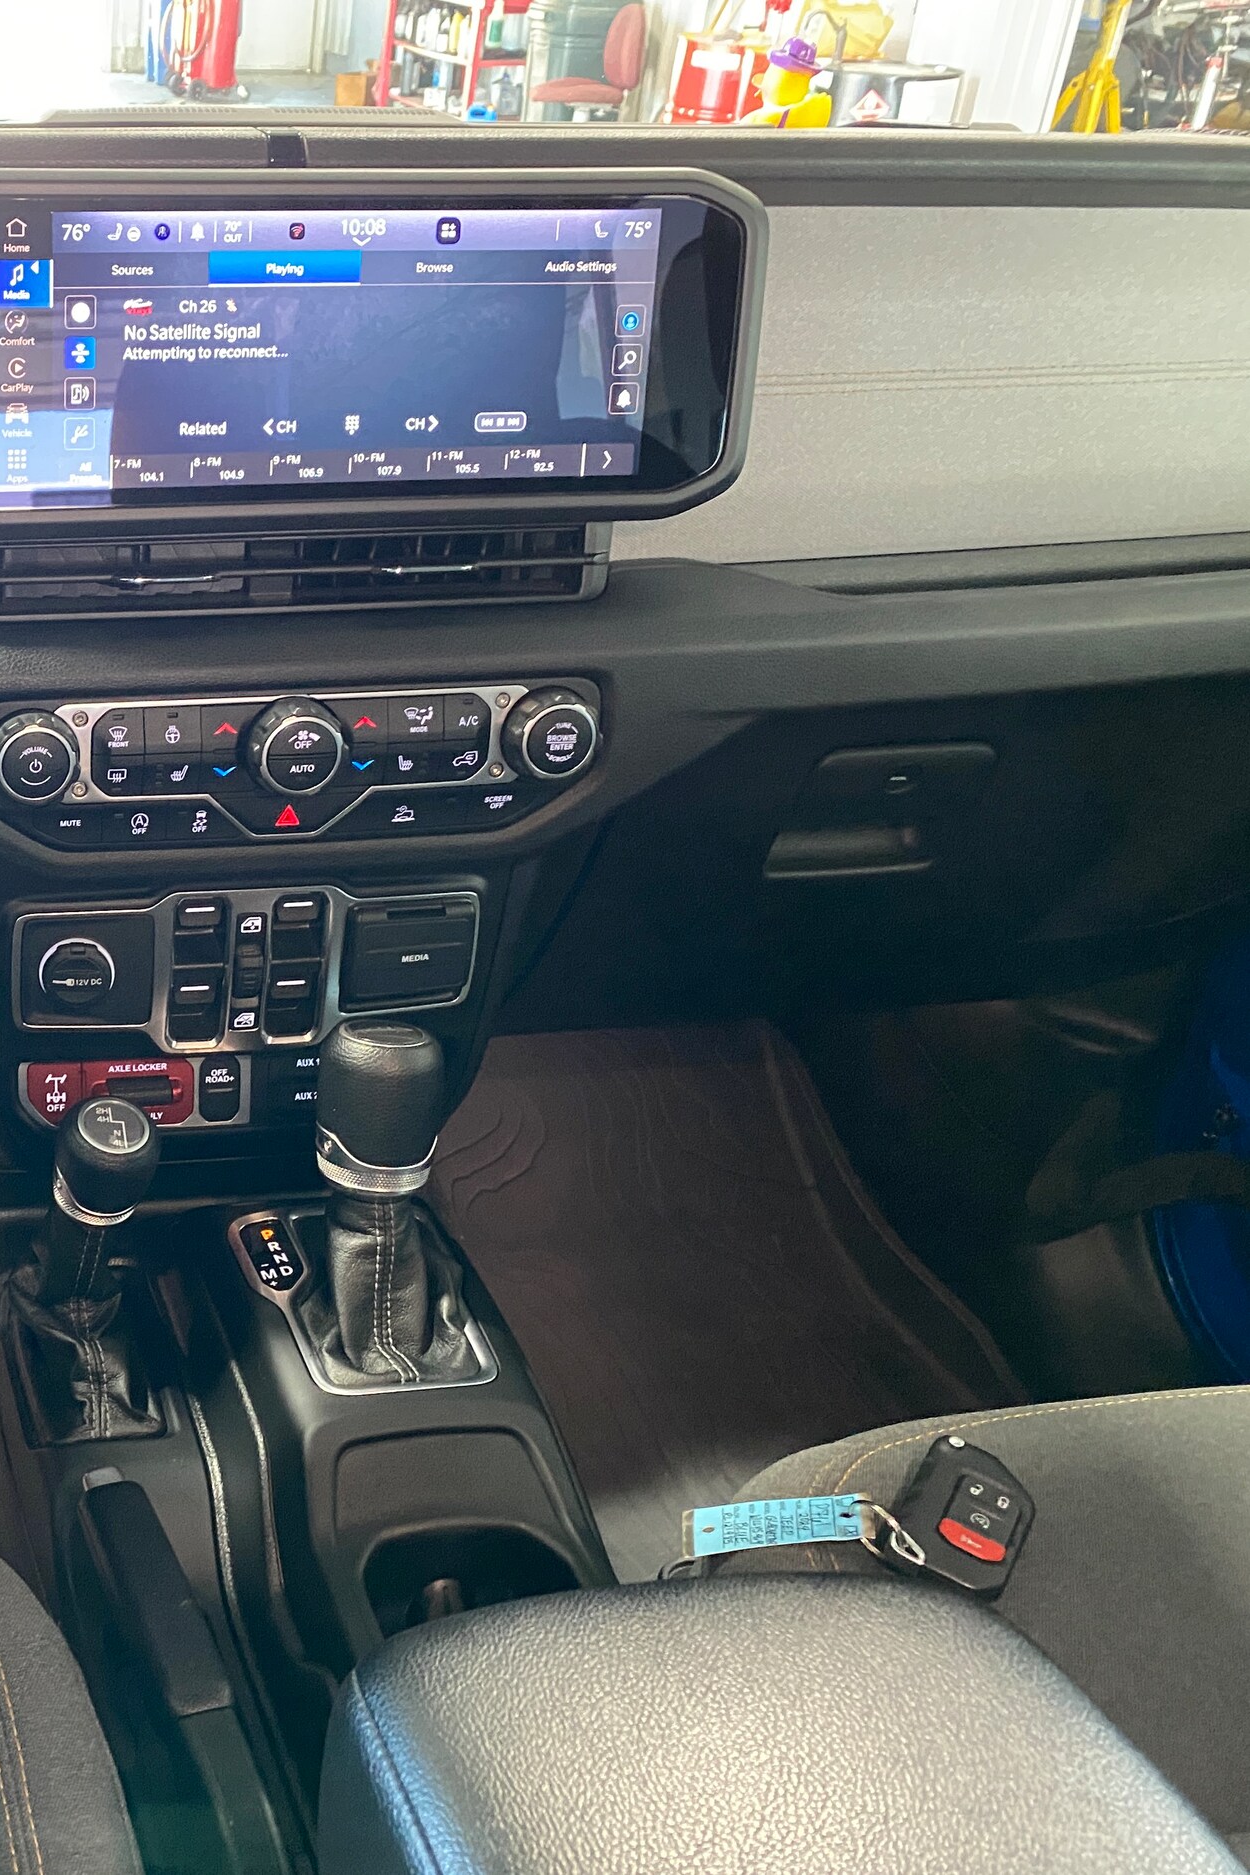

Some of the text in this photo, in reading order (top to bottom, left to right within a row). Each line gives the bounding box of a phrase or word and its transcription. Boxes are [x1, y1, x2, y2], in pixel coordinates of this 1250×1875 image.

[61, 223, 91, 241] 76°
[341, 219, 386, 235] 10:08
[624, 221, 652, 238] 75°
[223, 233, 242, 243] OUT
[3, 243, 31, 253] Home
[111, 264, 154, 276] Sources
[266, 263, 304, 277] Playing
[416, 262, 453, 273] Browse
[545, 261, 617, 274] Audio Settings
[3, 290, 30, 300] Media
[179, 299, 217, 313] Ch 26
[124, 323, 260, 343] No Satellite Signal
[0, 336, 35, 347] Comfort
[123, 346, 288, 363] Attempting to reconnect...
[0, 382, 34, 395] CarPlay
[179, 422, 226, 436] Related
[276, 420, 297, 434] CH
[405, 416, 425, 431] CH
[298, 467, 324, 478] 106.9
[377, 465, 402, 476] 107.9
[455, 463, 480, 474] 105.5
[534, 462, 554, 472] 92.5
[139, 472, 164, 482] 104.1
[219, 470, 244, 480] 104.9
[459, 716, 479, 727] A/C
[546, 734, 577, 742] BROWSE
[108, 740, 130, 748] FRONT
[294, 741, 312, 749] OFF
[549, 743, 574, 751] ENTER
[22, 746, 48, 755] VOLUME
[548, 754, 572, 762] SCROLL
[290, 764, 315, 773] AUTO
[484, 795, 513, 805] SCREEN
[490, 802, 505, 810] OFF
[60, 819, 81, 827] MUTE
[192, 825, 207, 833] OFF
[401, 953, 429, 962] MEDIA
[75, 977, 102, 986] 12V DC
[108, 1062, 168, 1073] AXLE LOCKER
[296, 1058, 315, 1067] AUX
[205, 1075, 235, 1084] ROAD+
[295, 1092, 312, 1100] AUX
[47, 1104, 65, 1112] OFF
[260, 1229, 274, 1240] P
[267, 1241, 282, 1252] R
[273, 1252, 289, 1264] N
[260, 1269, 278, 1281] M
[279, 1266, 294, 1276] D
[781, 1515, 794, 1536] JEEP
[735, 1522, 749, 1544] BLUE
